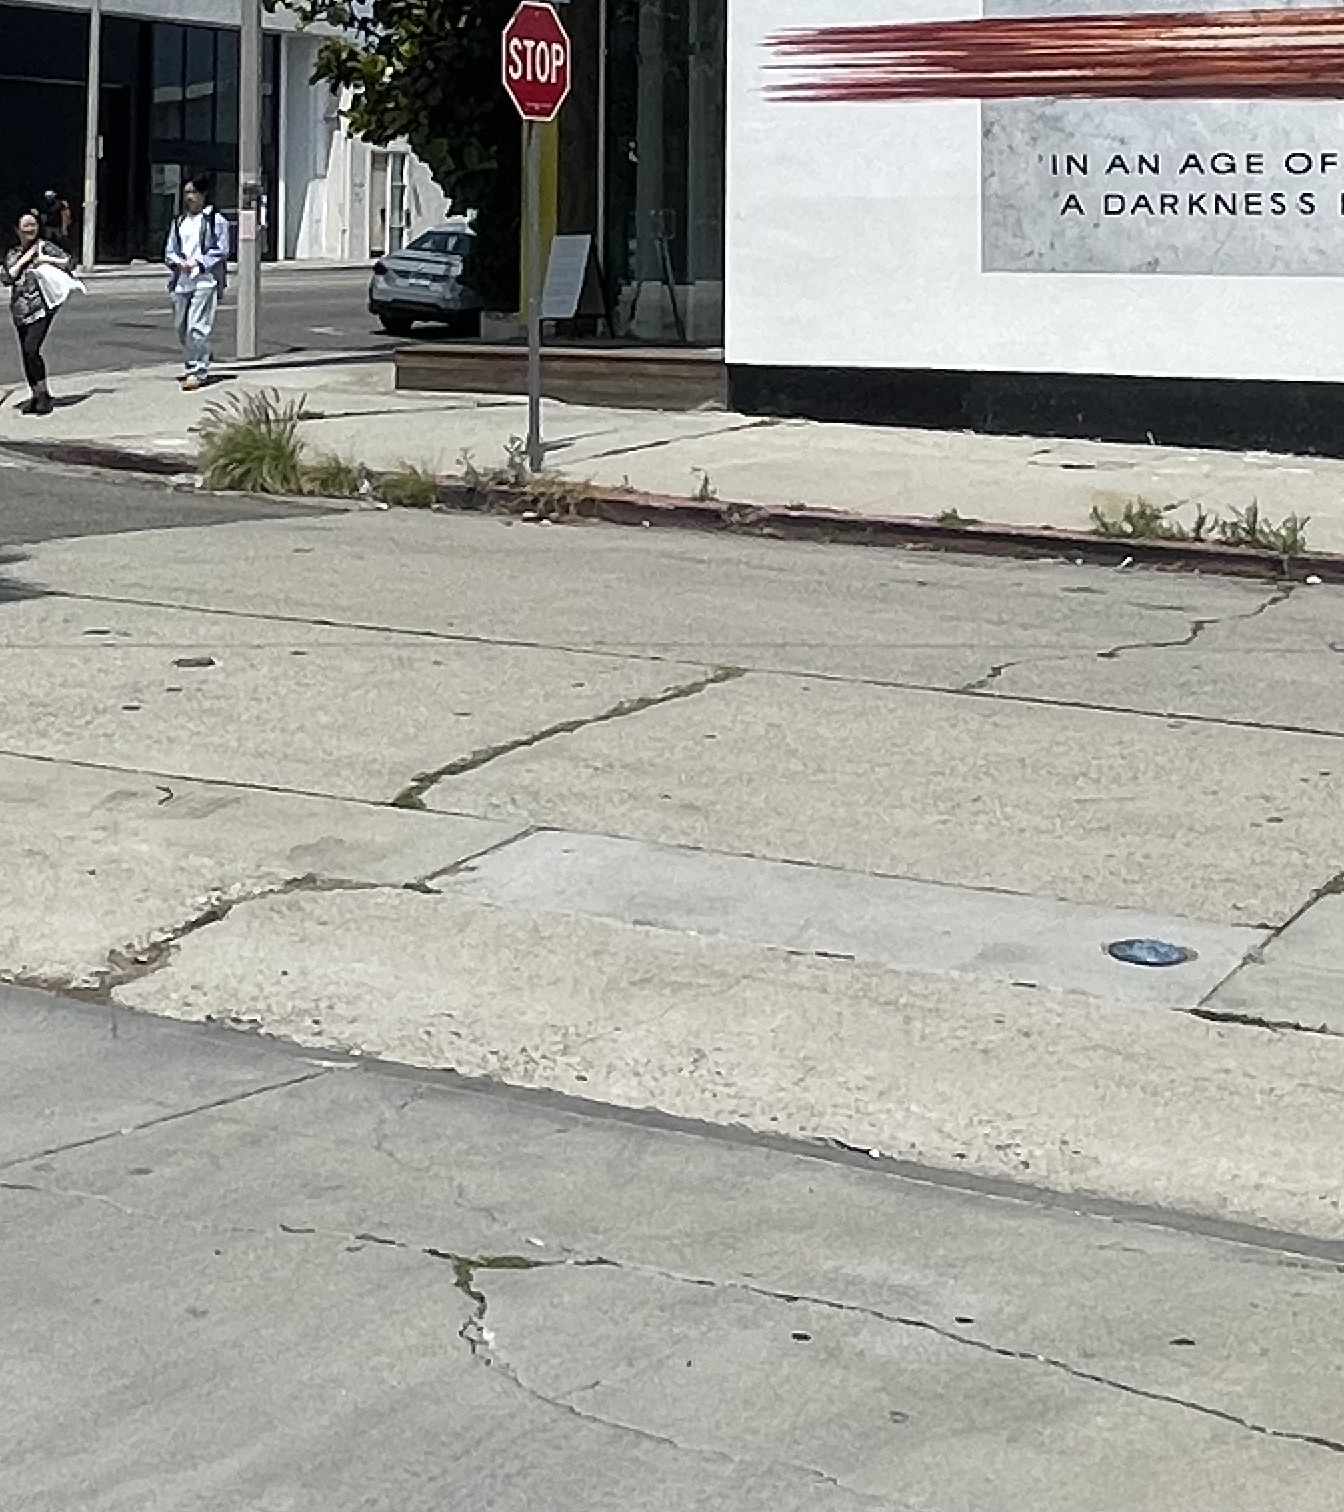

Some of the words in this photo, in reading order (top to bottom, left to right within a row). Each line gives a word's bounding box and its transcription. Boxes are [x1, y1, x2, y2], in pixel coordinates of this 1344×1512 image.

[508, 36, 565, 84] STOP
[1051, 153, 1088, 176] IN
[1105, 153, 1161, 176] AN
[1178, 152, 1265, 176] AGE
[1284, 152, 1339, 175] OF
[1059, 192, 1086, 216] A
[1103, 192, 1317, 217] DARKNESS
